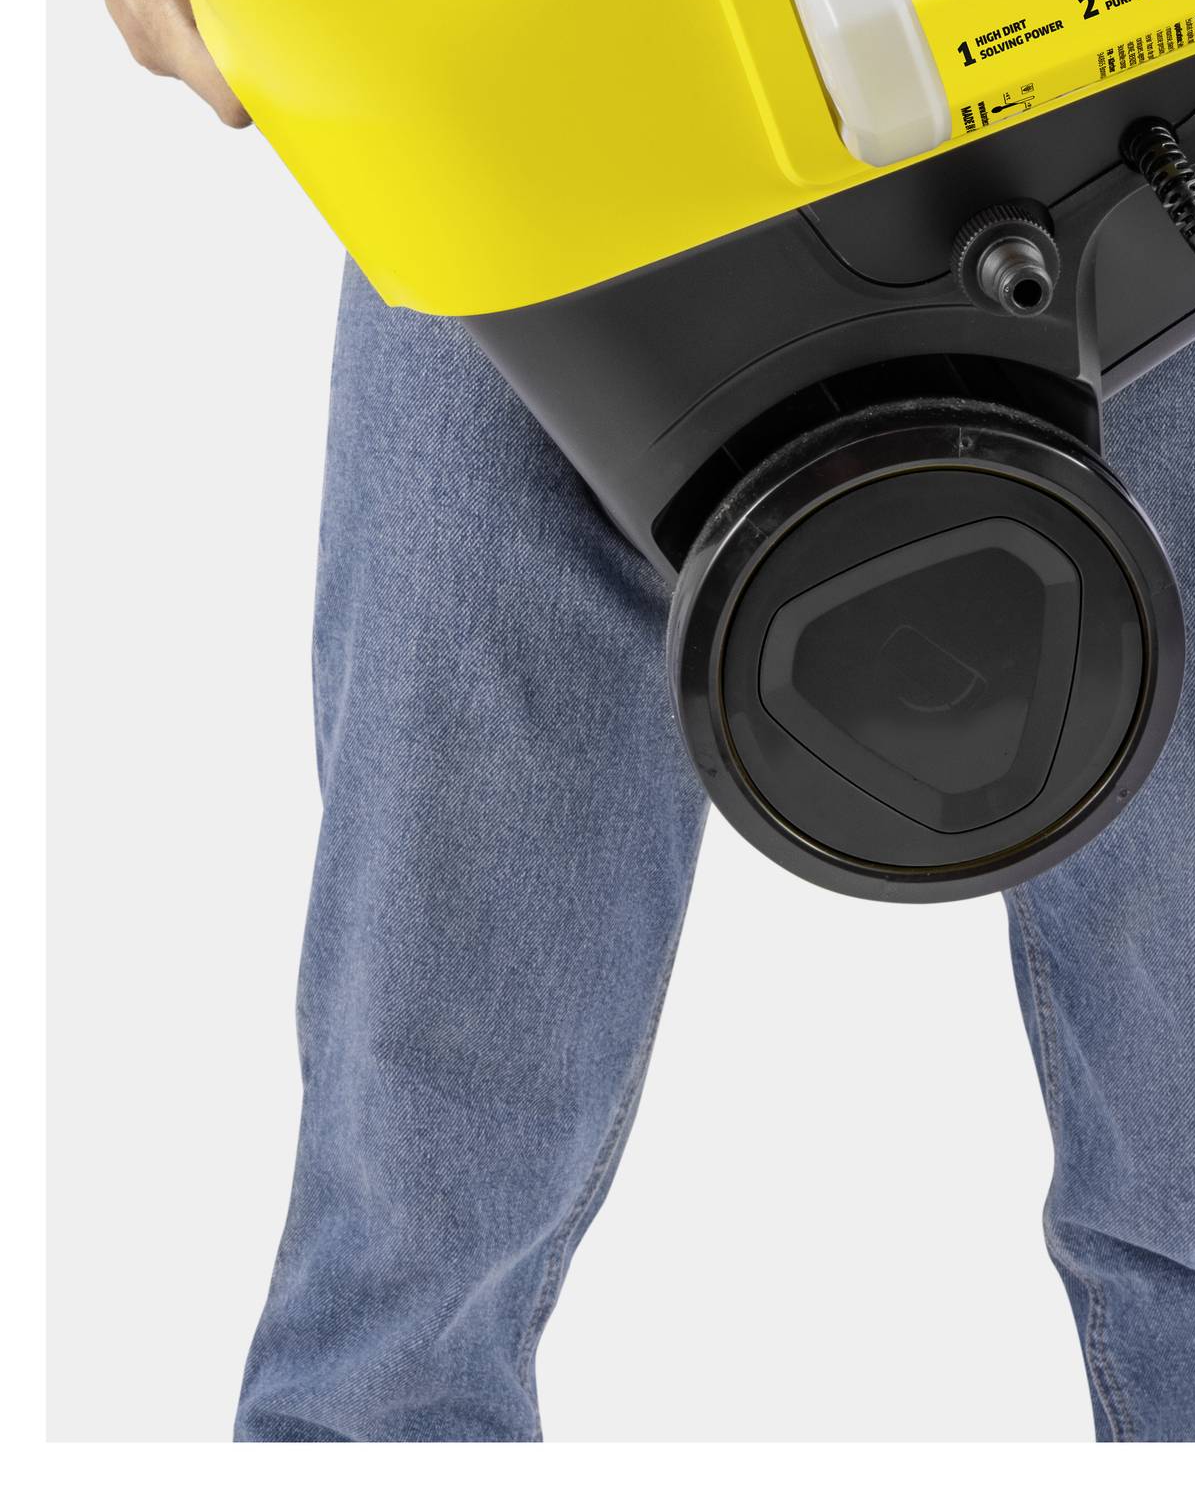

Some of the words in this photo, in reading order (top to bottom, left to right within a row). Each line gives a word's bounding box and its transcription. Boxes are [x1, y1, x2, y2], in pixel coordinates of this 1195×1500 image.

[957, 41, 977, 67] 1
[975, 30, 1002, 47] HIGH
[1002, 19, 1027, 36] DIRT
[980, 35, 1024, 60] SOLVING
[1024, 20, 1064, 42] POWER
